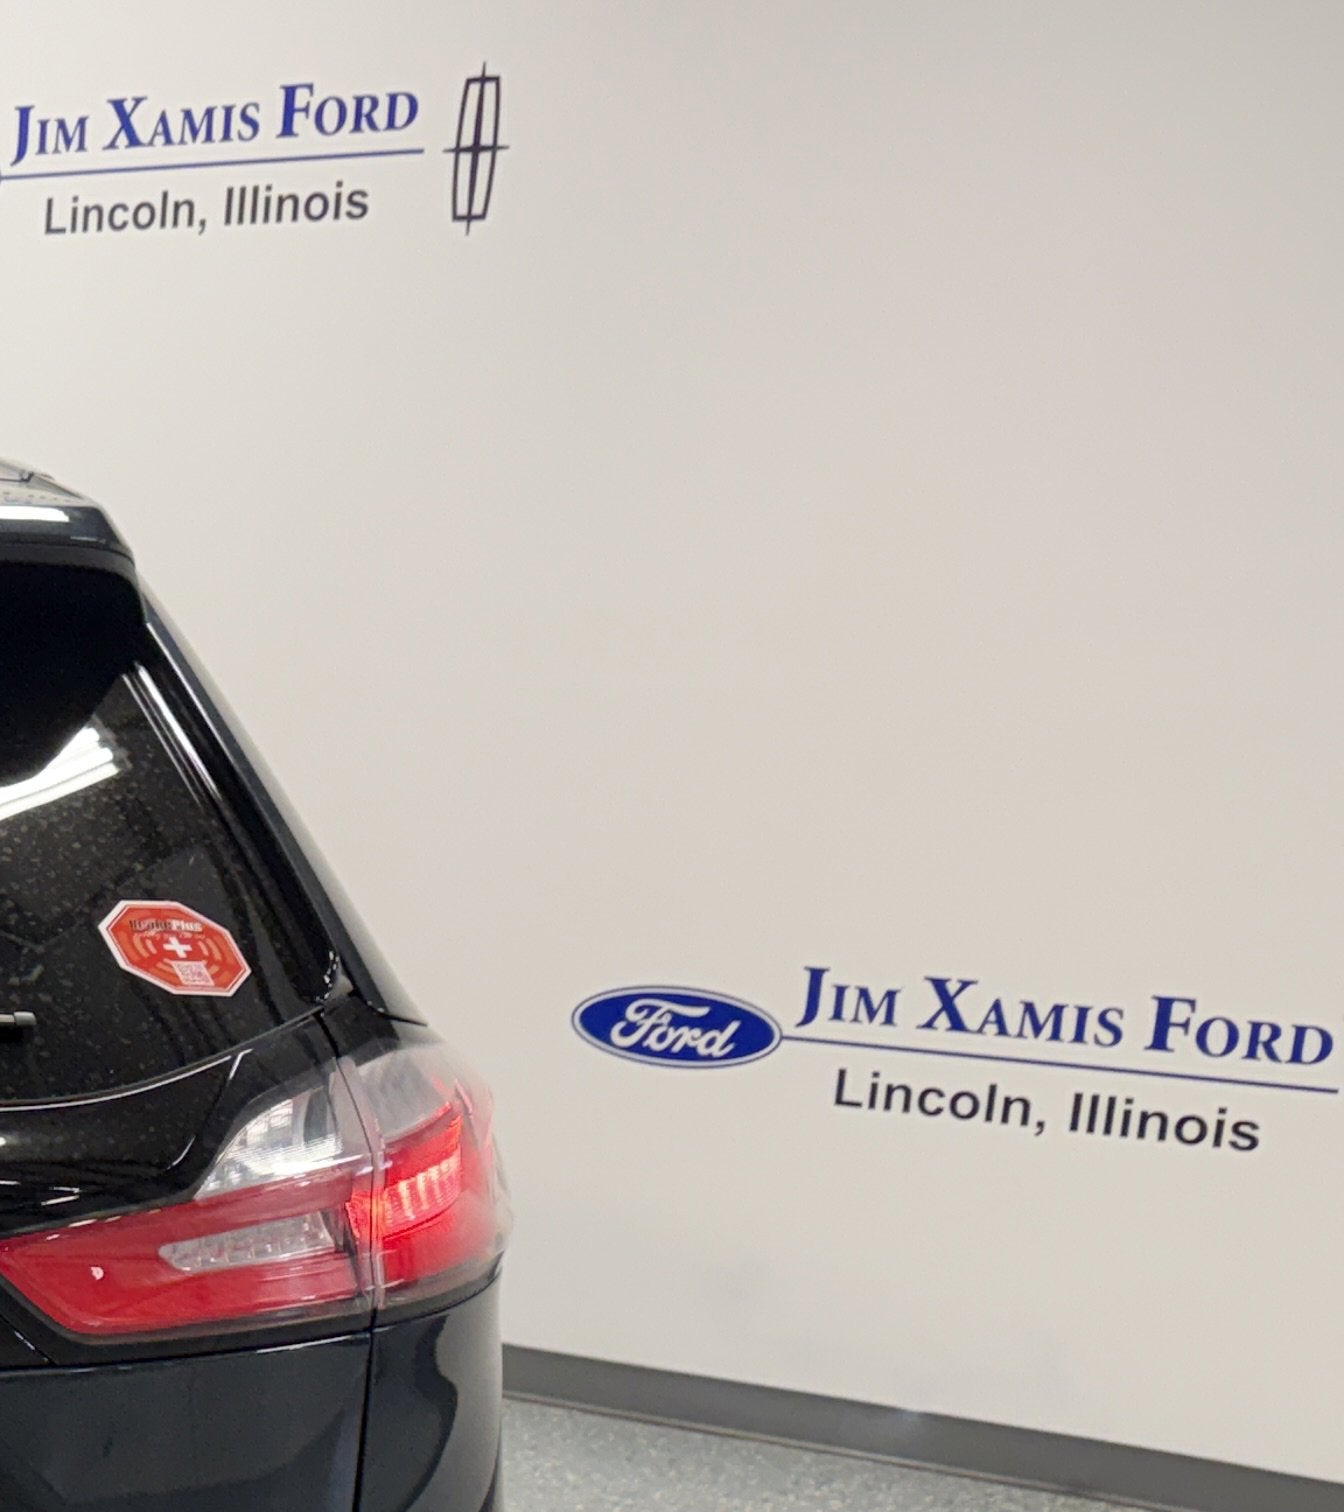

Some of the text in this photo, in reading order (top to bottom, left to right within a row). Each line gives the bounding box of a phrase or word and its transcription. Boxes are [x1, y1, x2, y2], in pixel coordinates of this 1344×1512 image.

[10, 82, 419, 167] JIM XAMIS FORD
[44, 179, 369, 235] Lincoln, Illinois
[611, 997, 740, 1060] Ford
[795, 966, 1334, 1066] JIM XAMIS FORD
[834, 1068, 1261, 1152] Lincoln, Illinois
